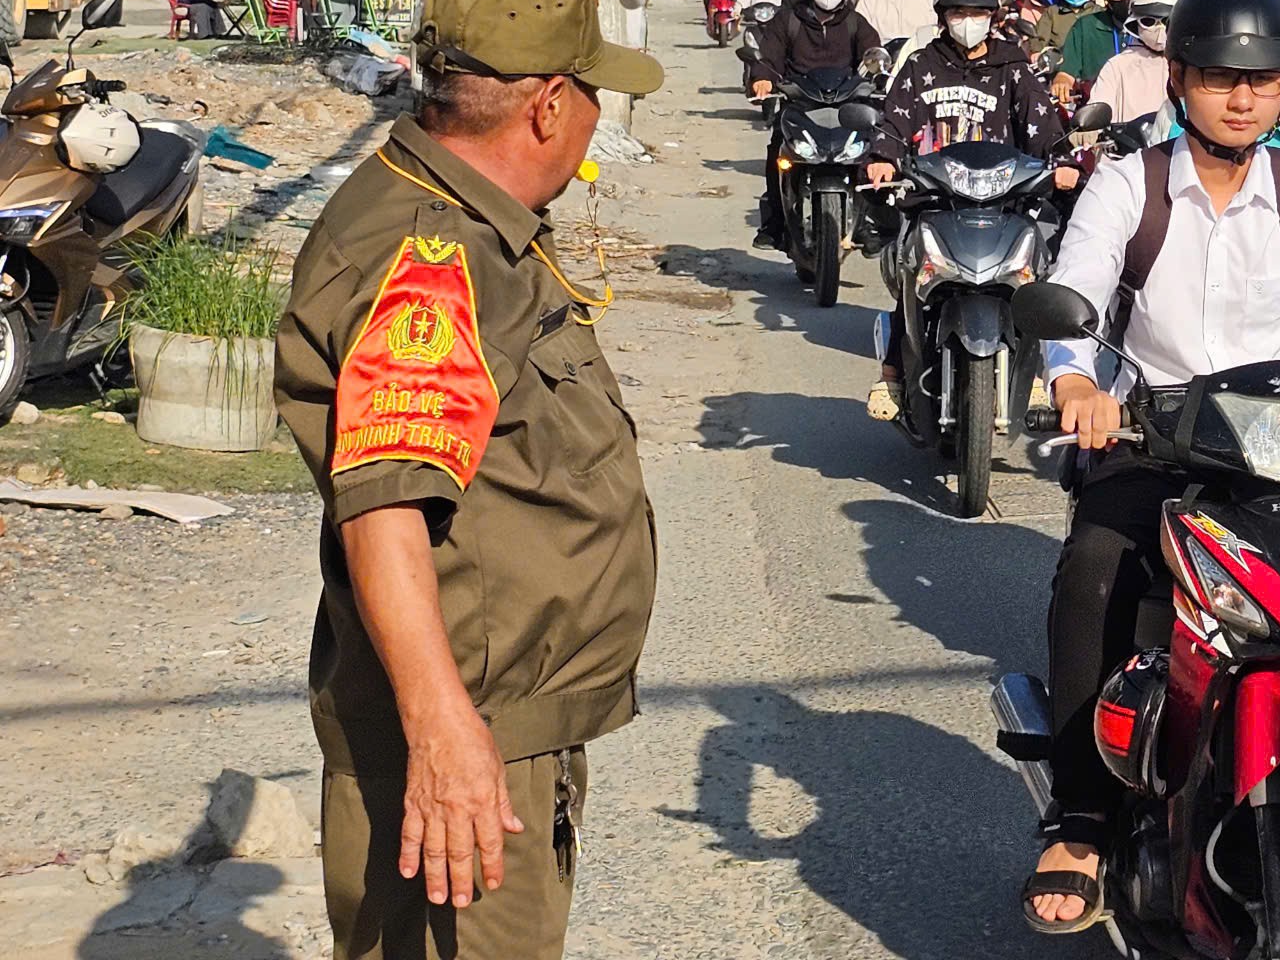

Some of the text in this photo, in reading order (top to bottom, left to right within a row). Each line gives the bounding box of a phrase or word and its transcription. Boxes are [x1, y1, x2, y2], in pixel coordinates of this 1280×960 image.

[373, 382, 446, 419] BẢO VỆ
[355, 422, 401, 450] NINH
